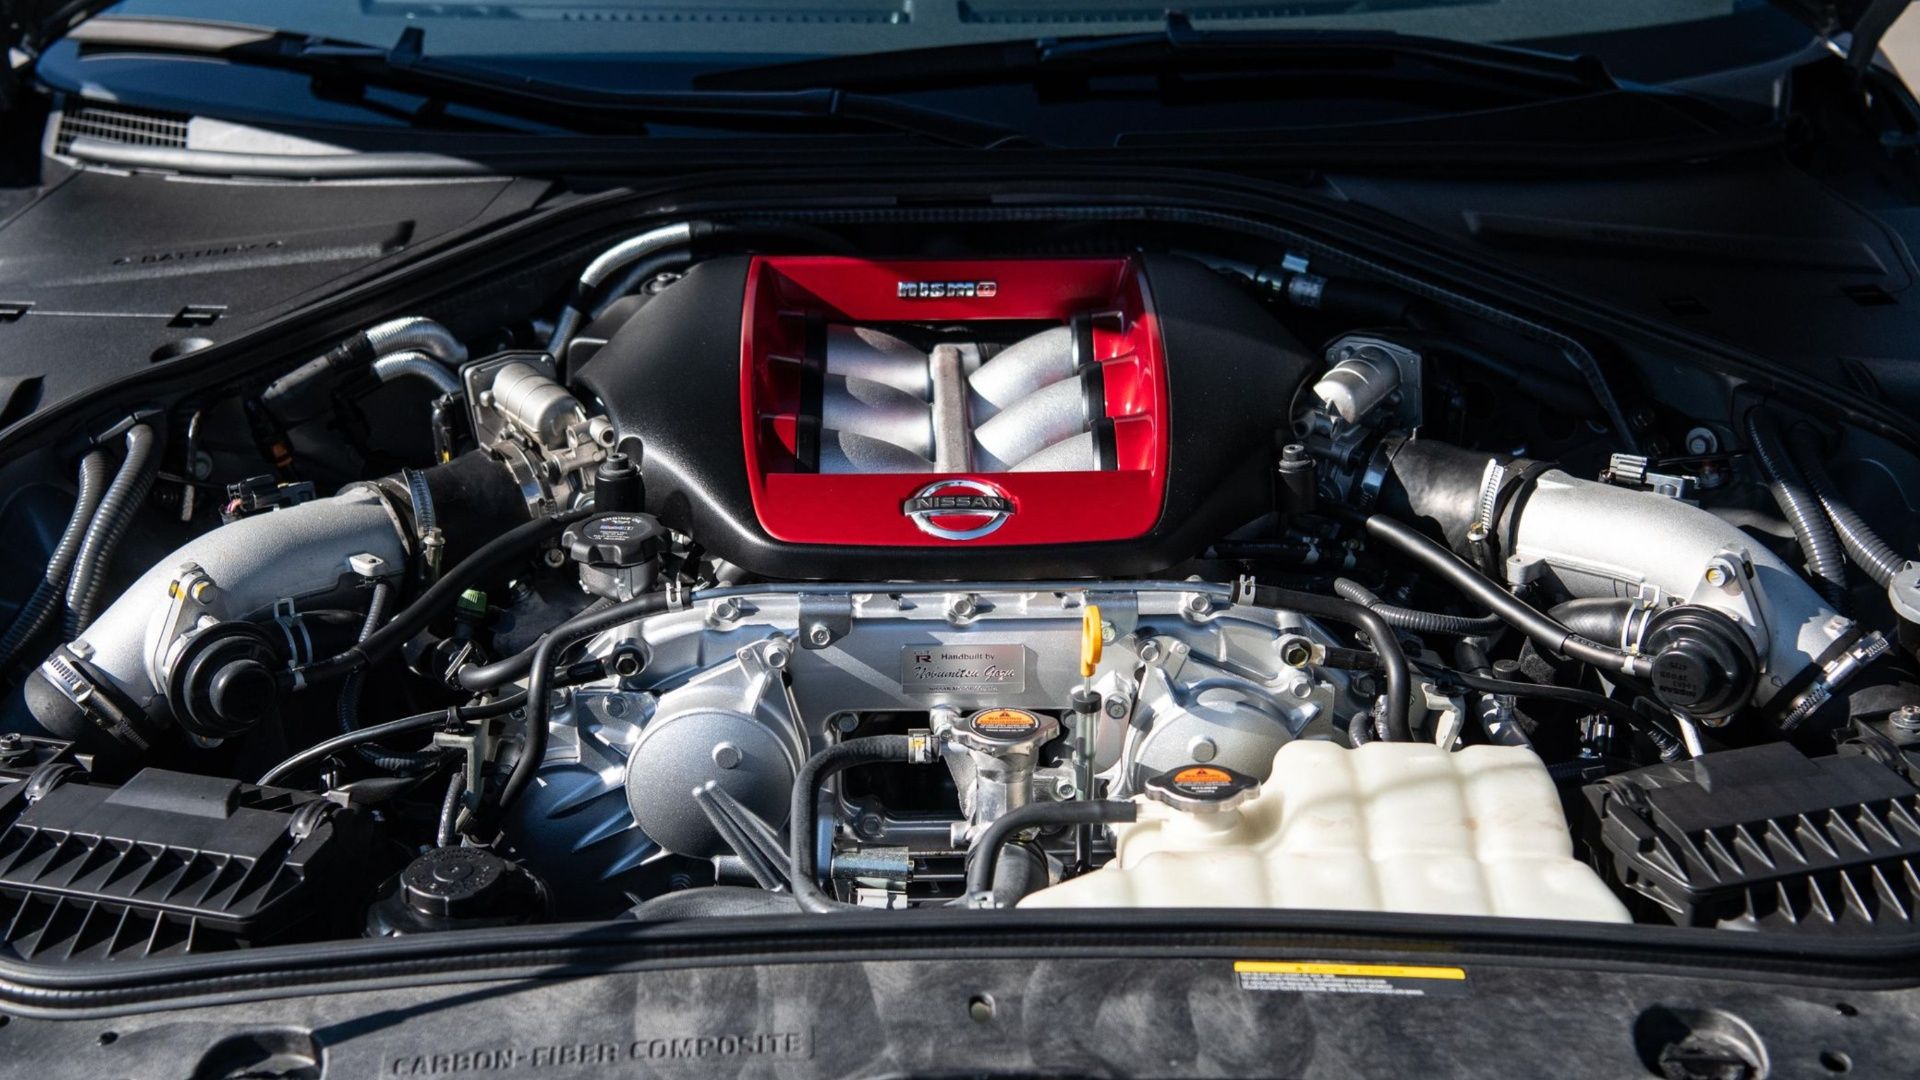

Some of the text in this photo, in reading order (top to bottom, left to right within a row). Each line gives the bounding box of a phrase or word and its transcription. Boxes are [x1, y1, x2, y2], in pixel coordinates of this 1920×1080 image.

[897, 281, 997, 297] nismo
[917, 496, 1005, 508] NISSAN
[941, 653, 983, 661] Handbuilt
[985, 653, 995, 661] by
[392, 1031, 801, 1077] CARBON-FIBER COMPOSITE
